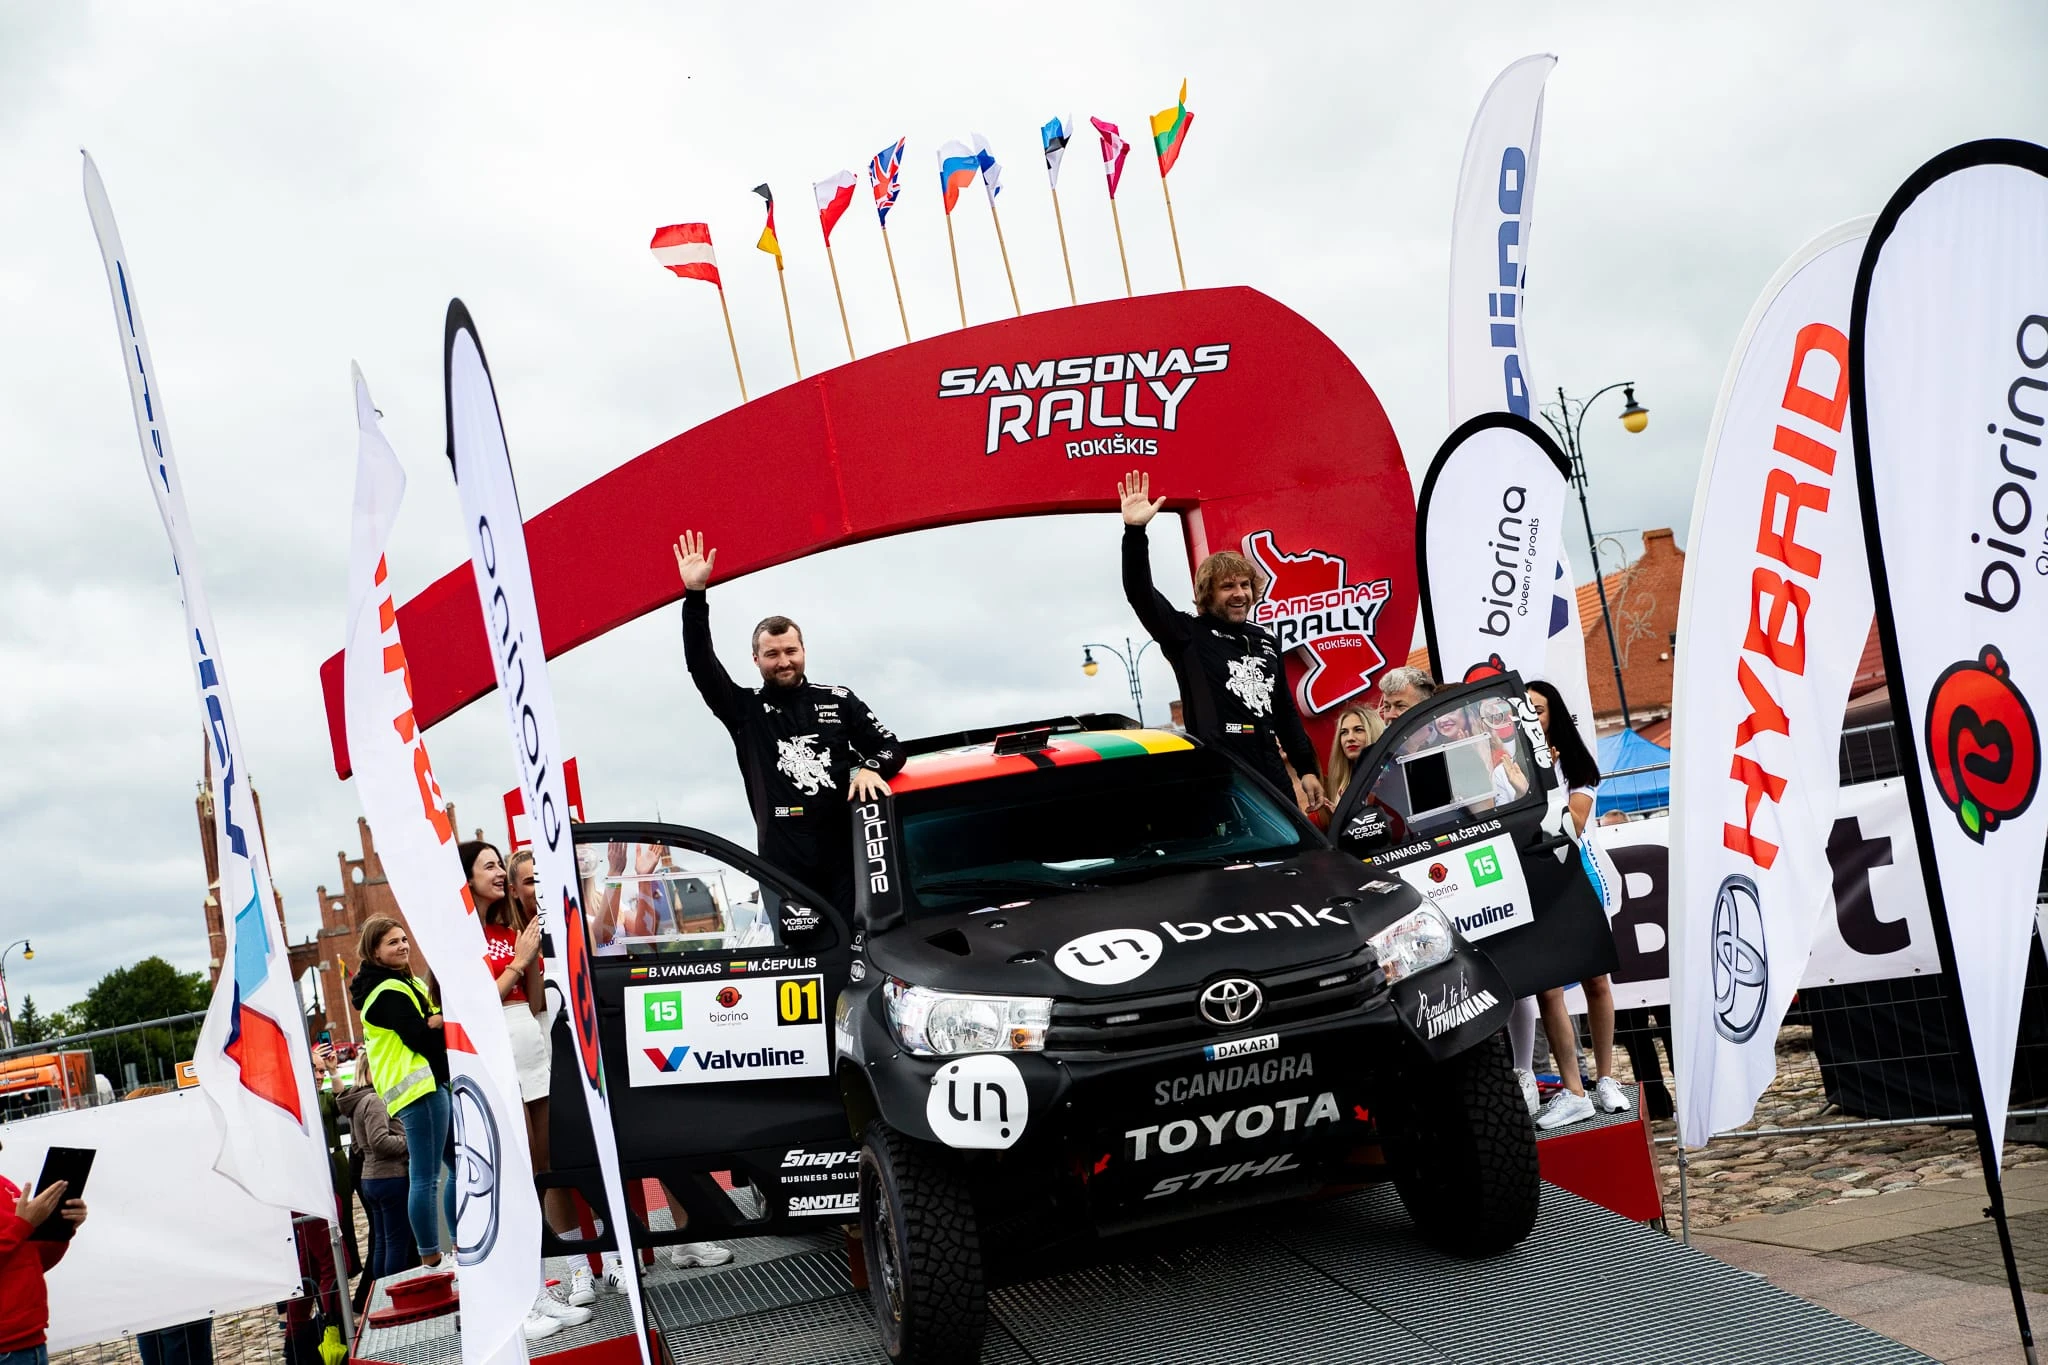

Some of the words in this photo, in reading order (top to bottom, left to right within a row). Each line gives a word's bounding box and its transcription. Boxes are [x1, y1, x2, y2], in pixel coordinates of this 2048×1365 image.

[938, 344, 1230, 397] SAMSONAS
[985, 377, 1197, 455] RALLY
[1065, 433, 1158, 459] ROKIŠKIS
[1527, 518, 1540, 557] groats
[1478, 485, 1527, 637] biorina
[1524, 558, 1533, 572] of
[1258, 583, 1387, 622] SAMSONAS
[1517, 575, 1531, 616] Queen
[1723, 322, 1850, 870] HYBRID
[1277, 602, 1377, 643] RALLY
[1317, 637, 1362, 651] ROKIŠKIS
[1347, 821, 1387, 836] VOSTOK
[1354, 829, 1383, 840] EUROPE
[1373, 841, 1432, 866] B.VANAGAS
[1448, 819, 1501, 843] M.ČEPULIS
[856, 803, 889, 894] pitlane
[1473, 855, 1497, 877] 15
[1427, 882, 1459, 899] biorina
[782, 917, 819, 926] VOSTOK
[1160, 904, 1350, 943] bank
[648, 963, 722, 978] B.VANAGAS
[748, 957, 817, 972] M.ČEPULIS
[650, 1000, 677, 1022] 15
[709, 1010, 749, 1023] biorina
[780, 980, 818, 1022] 01
[1427, 989, 1499, 1040] LITHUANIAN
[693, 1047, 804, 1070] Valvoline
[1218, 1037, 1276, 1059] DAKAR1
[1154, 1052, 1314, 1106] SCANDAGRA
[1125, 1092, 1341, 1161] TOYOTA
[780, 1173, 828, 1184] BUSINESS
[1143, 1153, 1301, 1199] STIHL
